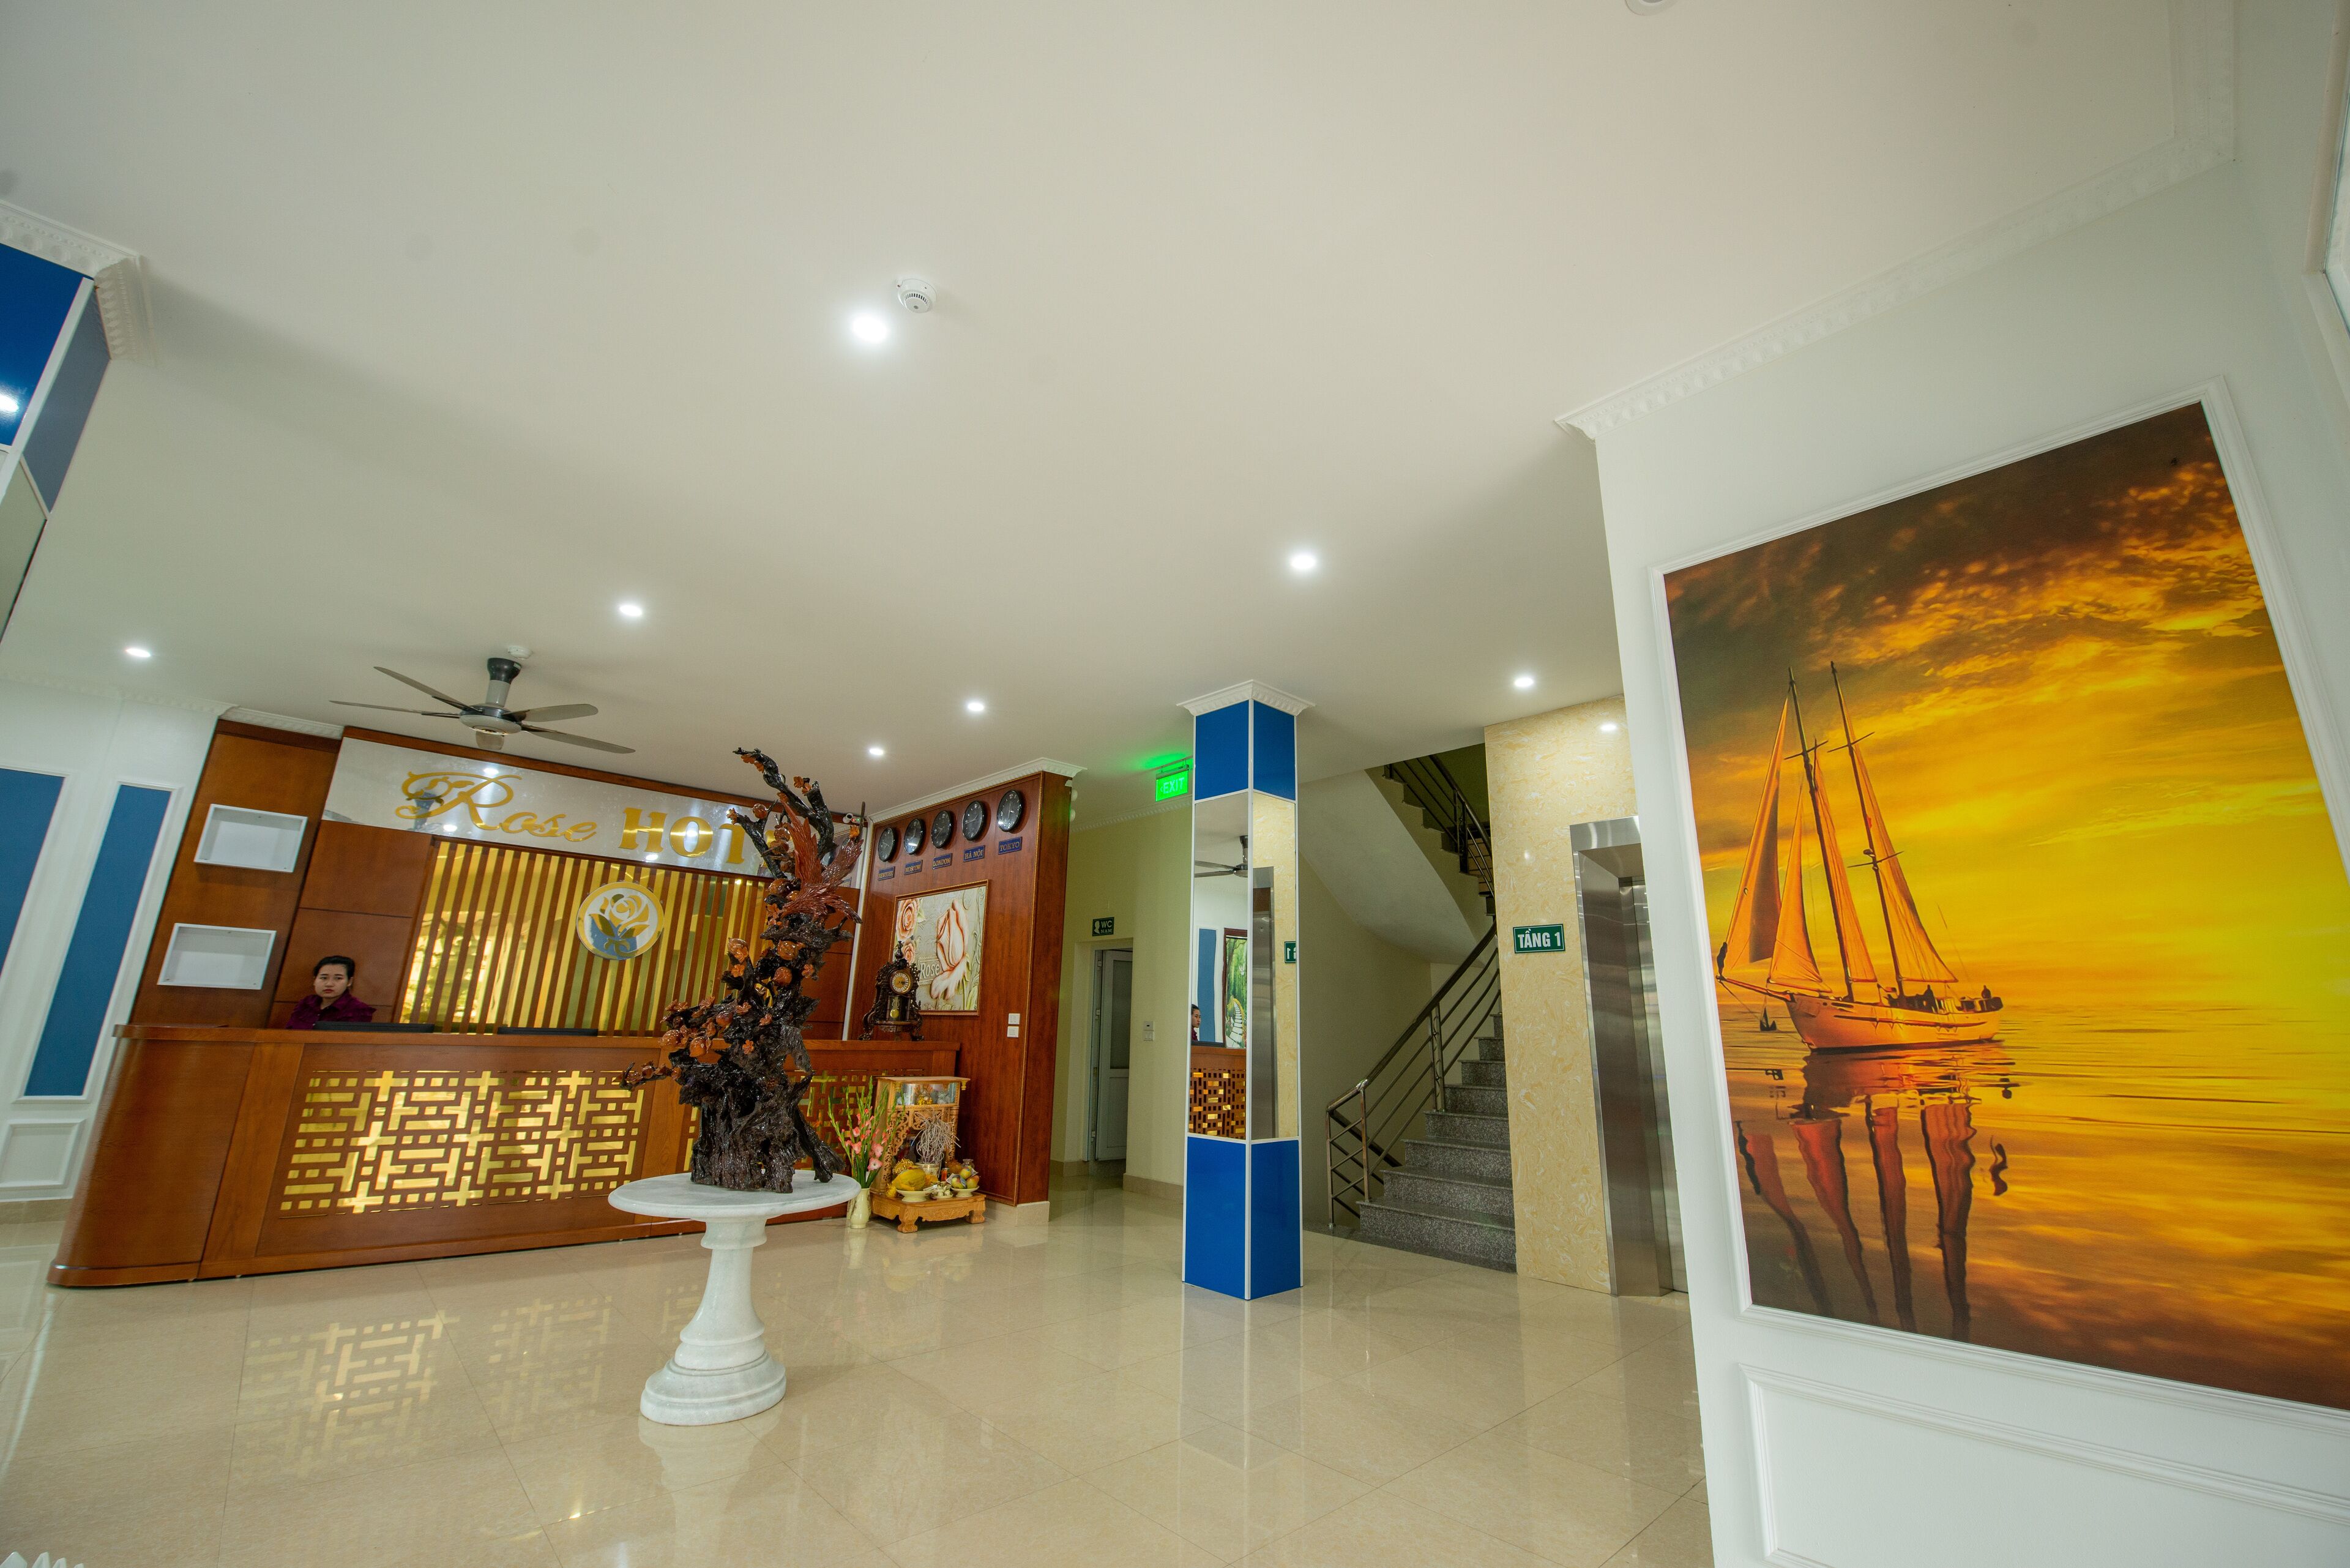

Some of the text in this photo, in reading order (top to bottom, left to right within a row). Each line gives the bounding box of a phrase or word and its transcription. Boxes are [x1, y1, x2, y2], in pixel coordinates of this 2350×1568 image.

[1163, 777, 1185, 794] EXIT
[395, 771, 597, 842] Rose
[999, 842, 1020, 851] TOKYO
[933, 858, 950, 867] LONDON
[1518, 928, 1561, 949] TẦNG 1
[919, 962, 940, 980] Rose
